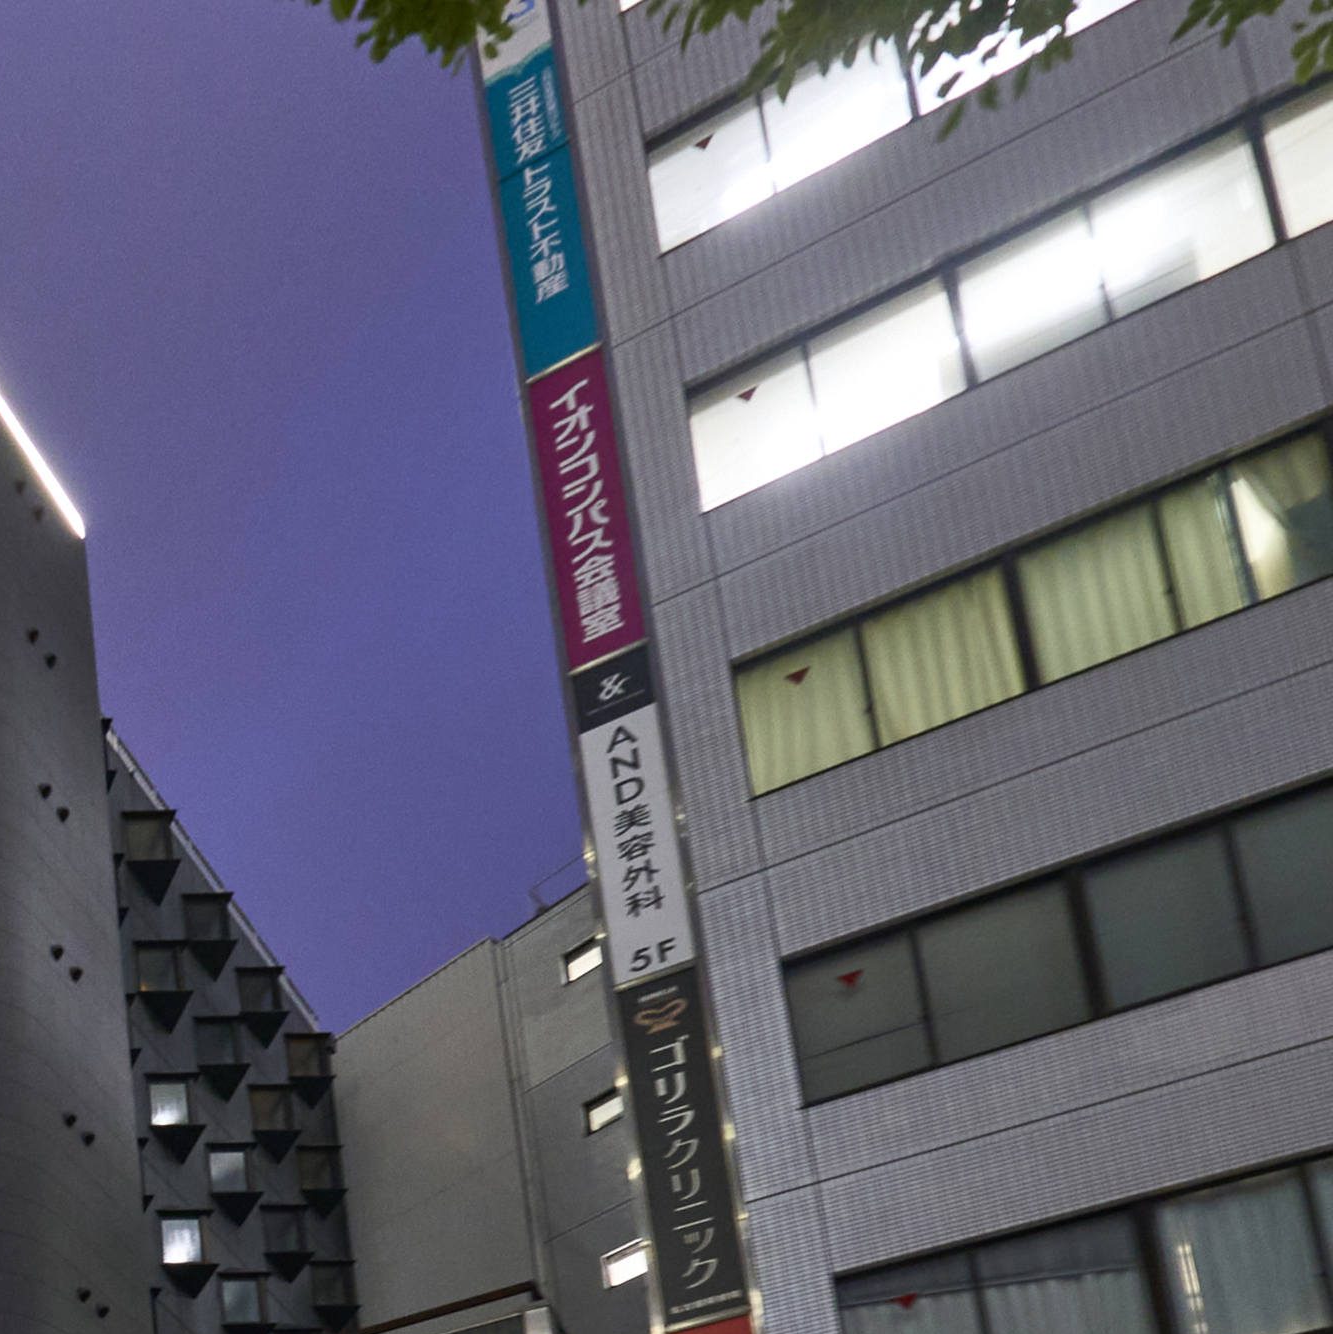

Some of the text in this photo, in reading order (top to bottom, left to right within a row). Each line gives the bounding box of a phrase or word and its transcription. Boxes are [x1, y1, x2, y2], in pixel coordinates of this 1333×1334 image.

[507, 75, 570, 305] 三井住友トラスト不動産
[549, 377, 625, 643] イオンコンパス会議室
[606, 725, 665, 917] AND美容外科
[629, 937, 677, 973] 5F
[649, 1034, 719, 1289] ゴリラクリニック
